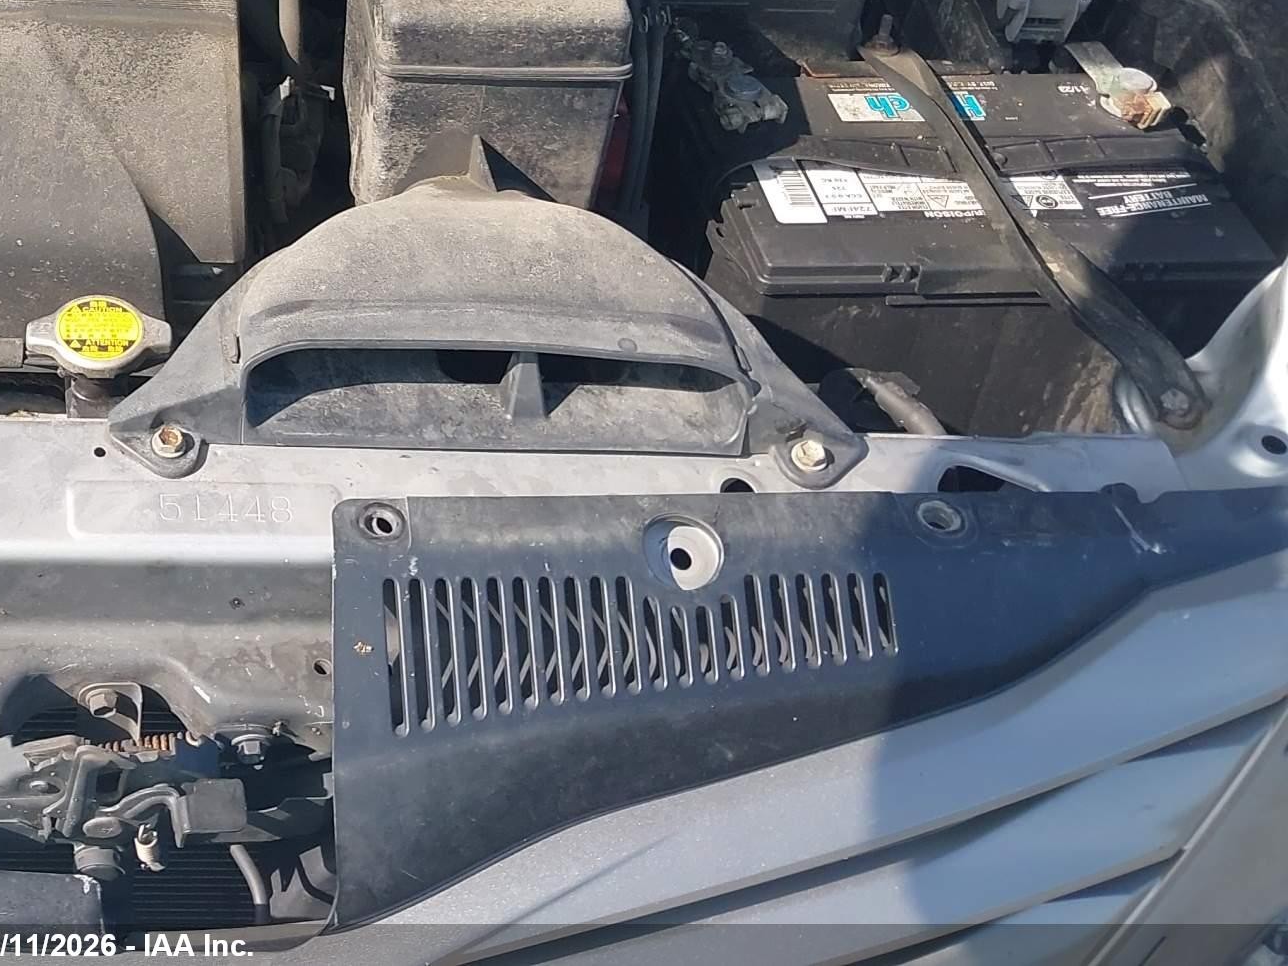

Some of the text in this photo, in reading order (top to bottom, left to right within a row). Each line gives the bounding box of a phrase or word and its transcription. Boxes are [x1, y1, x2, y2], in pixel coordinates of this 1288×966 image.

[1096, 194, 1209, 216] MAINTENANCE-FREE
[1123, 191, 1173, 204] BATTERY
[85, 339, 129, 347] ATTENTION
[159, 492, 293, 523] 51448
